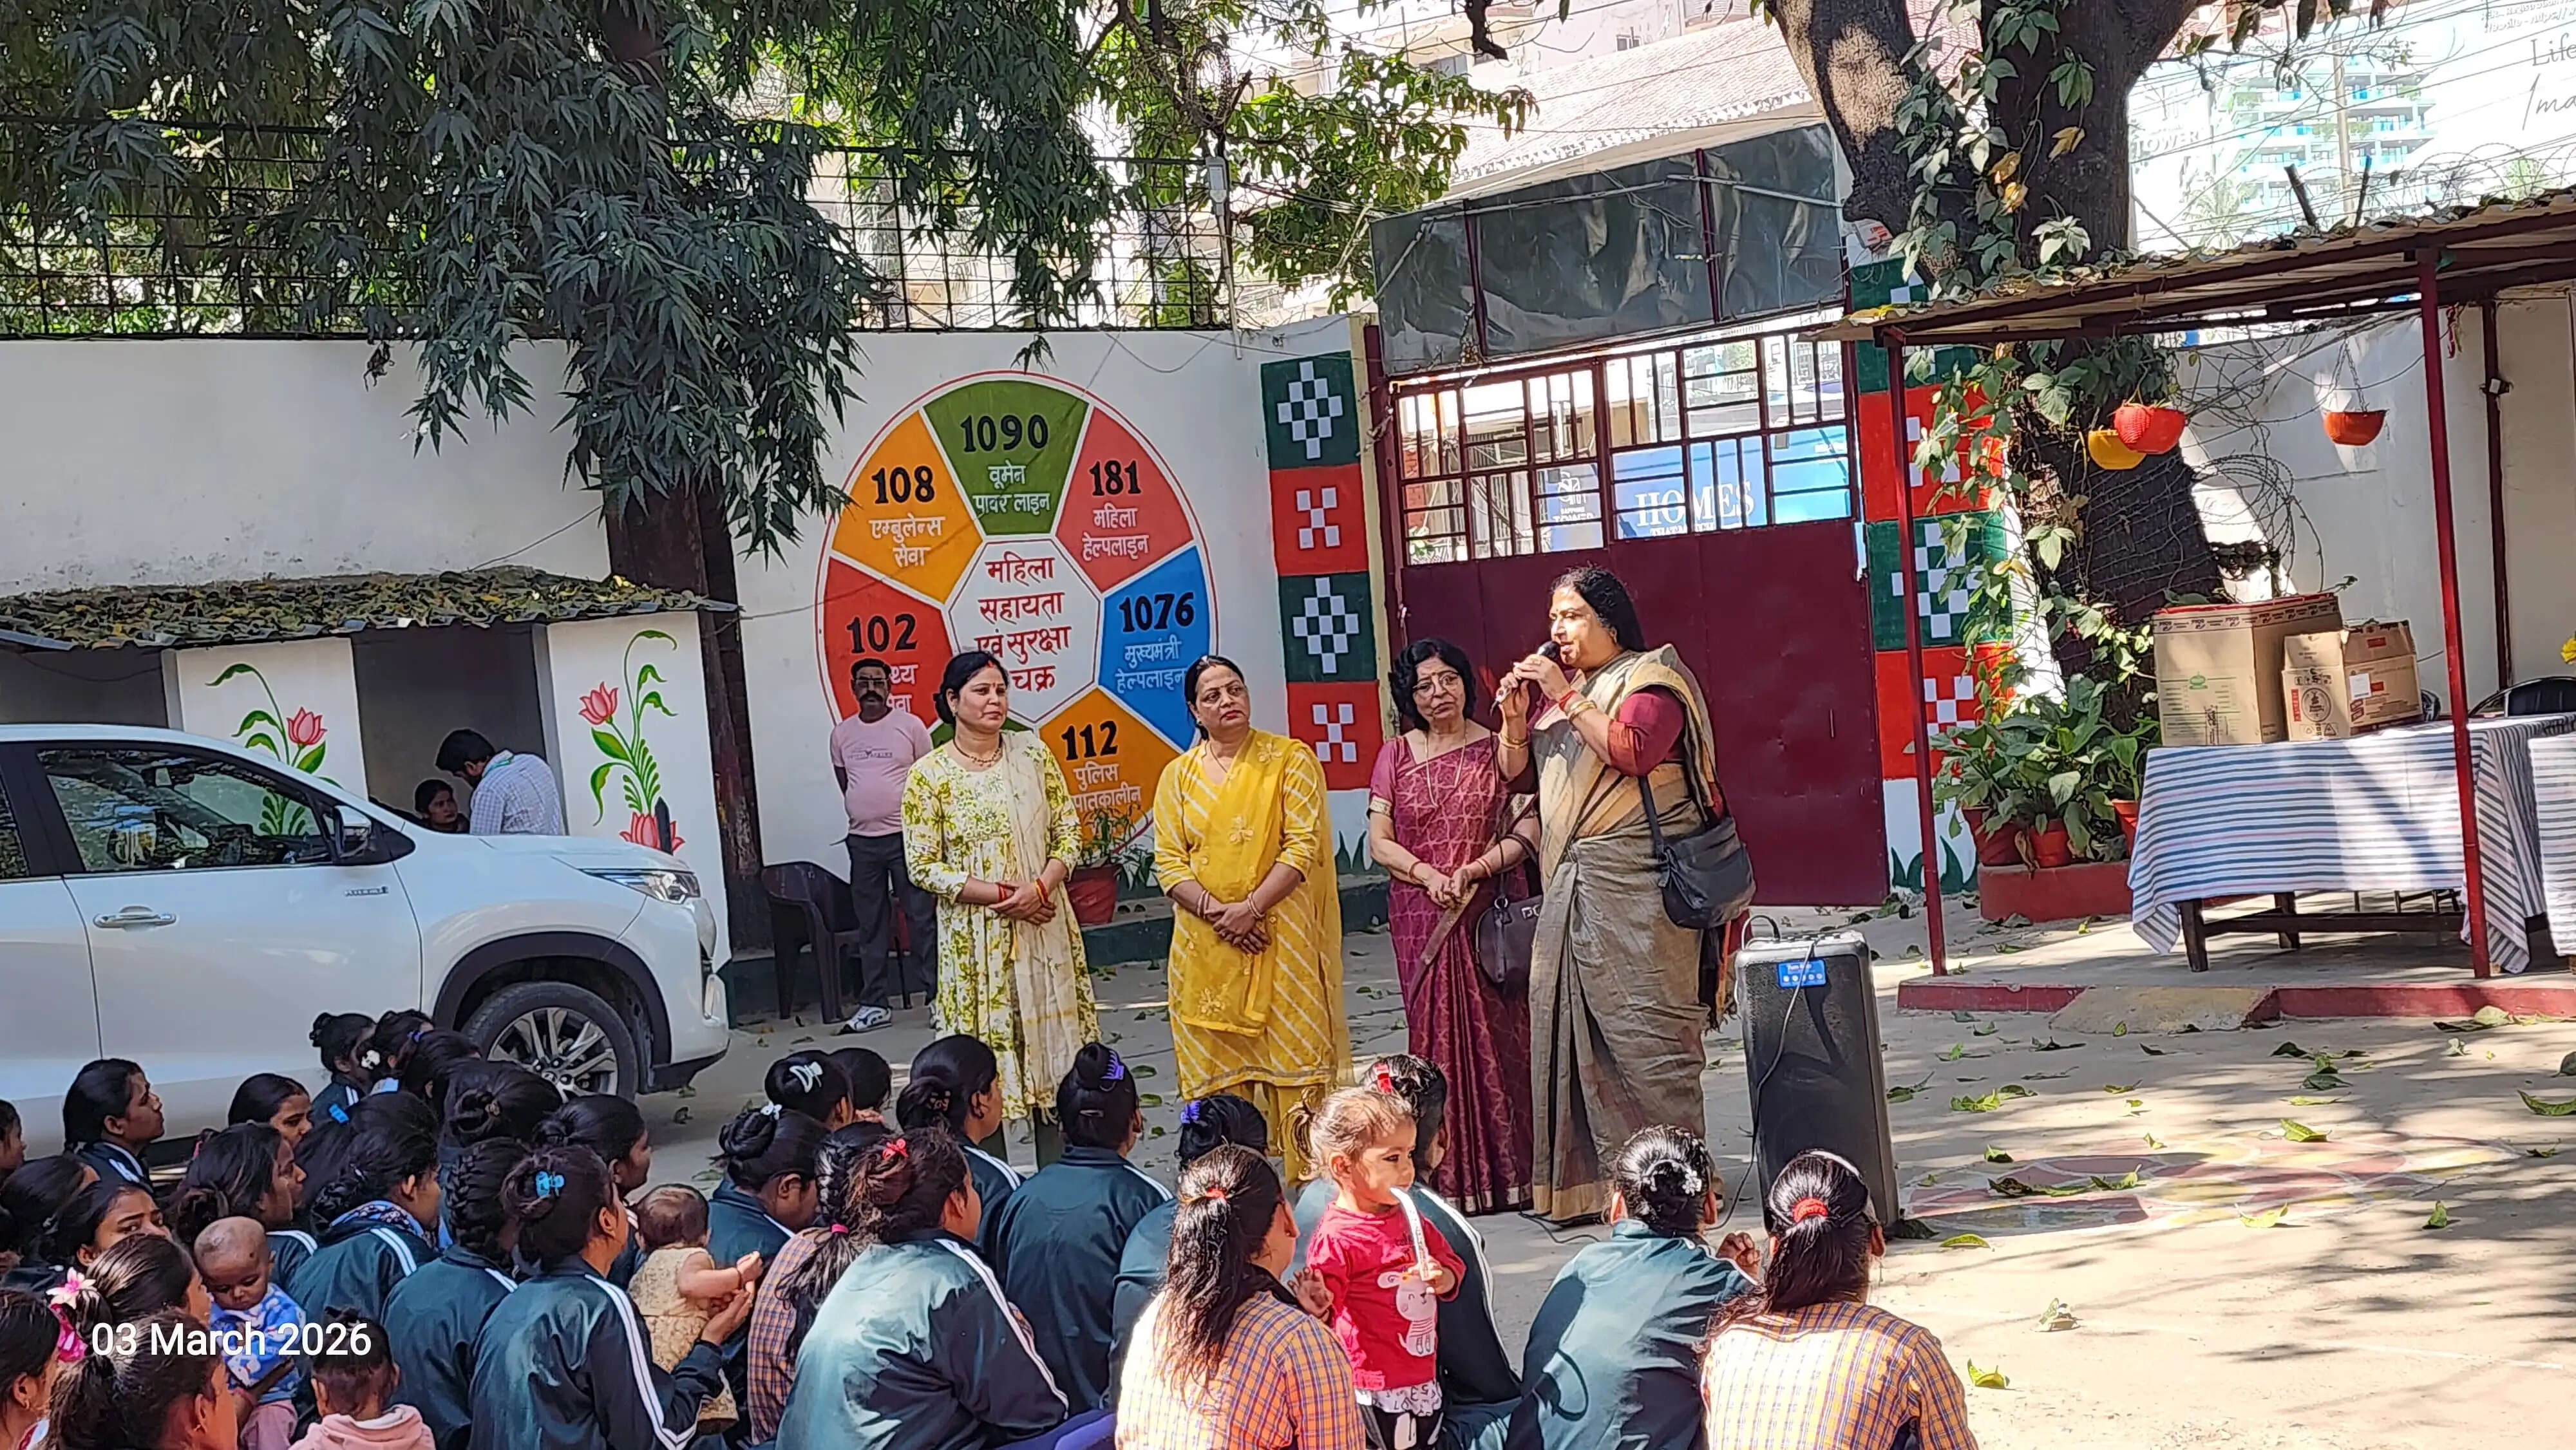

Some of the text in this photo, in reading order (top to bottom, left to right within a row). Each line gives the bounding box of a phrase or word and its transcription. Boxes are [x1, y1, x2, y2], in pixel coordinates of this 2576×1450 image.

[960, 414, 1049, 453] 1090
[871, 466, 936, 505] 108
[1089, 460, 1141, 496] 181
[973, 493, 1051, 516] पावर लाइन
[1094, 503, 1138, 529] महिला
[1635, 480, 1755, 528] HOMES
[893, 545, 931, 568] सेवा
[1083, 533, 1151, 562] हेल्पलाइन
[985, 551, 1056, 587] महिला
[978, 592, 1065, 625] सहायता
[1119, 592, 1195, 633] 1076
[846, 613, 918, 654] 102
[1006, 626, 1072, 664] सुरक्षा
[1123, 634, 1182, 669] मुख्यमंत्री
[1009, 665, 1057, 693] चक्र
[1115, 667, 1187, 695] हेल्पलाइन
[1061, 720, 1119, 761] 112
[1073, 760, 1120, 792] पुलिस
